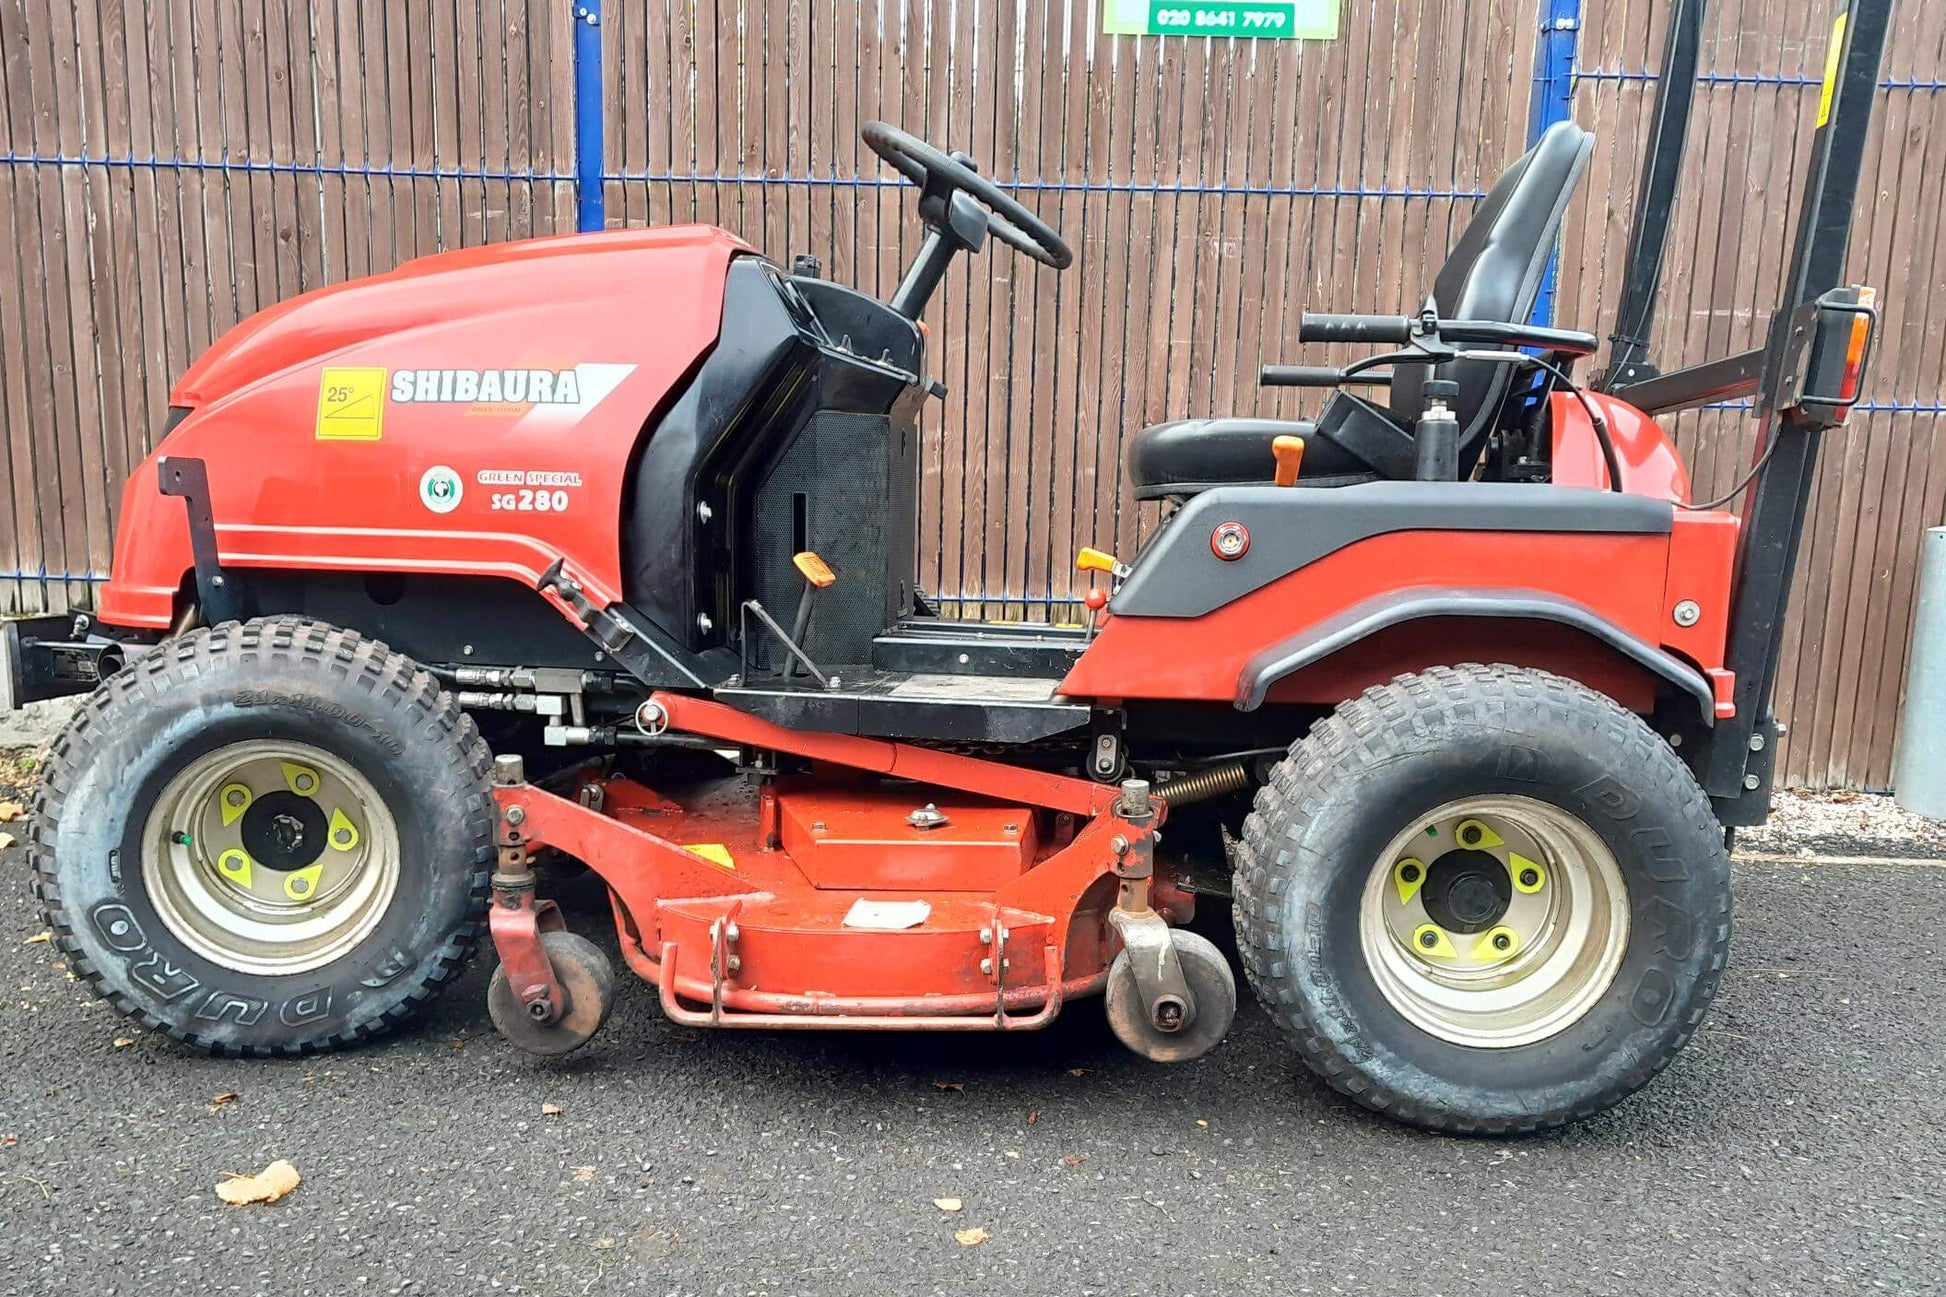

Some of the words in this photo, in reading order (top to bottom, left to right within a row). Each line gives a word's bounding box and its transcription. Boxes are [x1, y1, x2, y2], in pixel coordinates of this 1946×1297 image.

[1157, 9, 1191, 26] 020
[1242, 11, 1286, 28] 7979
[391, 368, 580, 404] SHIBAURA
[478, 471, 524, 483] GREEN
[528, 472, 581, 485] SPECIAL
[1572, 774, 1693, 1027] DURO
[93, 903, 335, 1029] DURO
